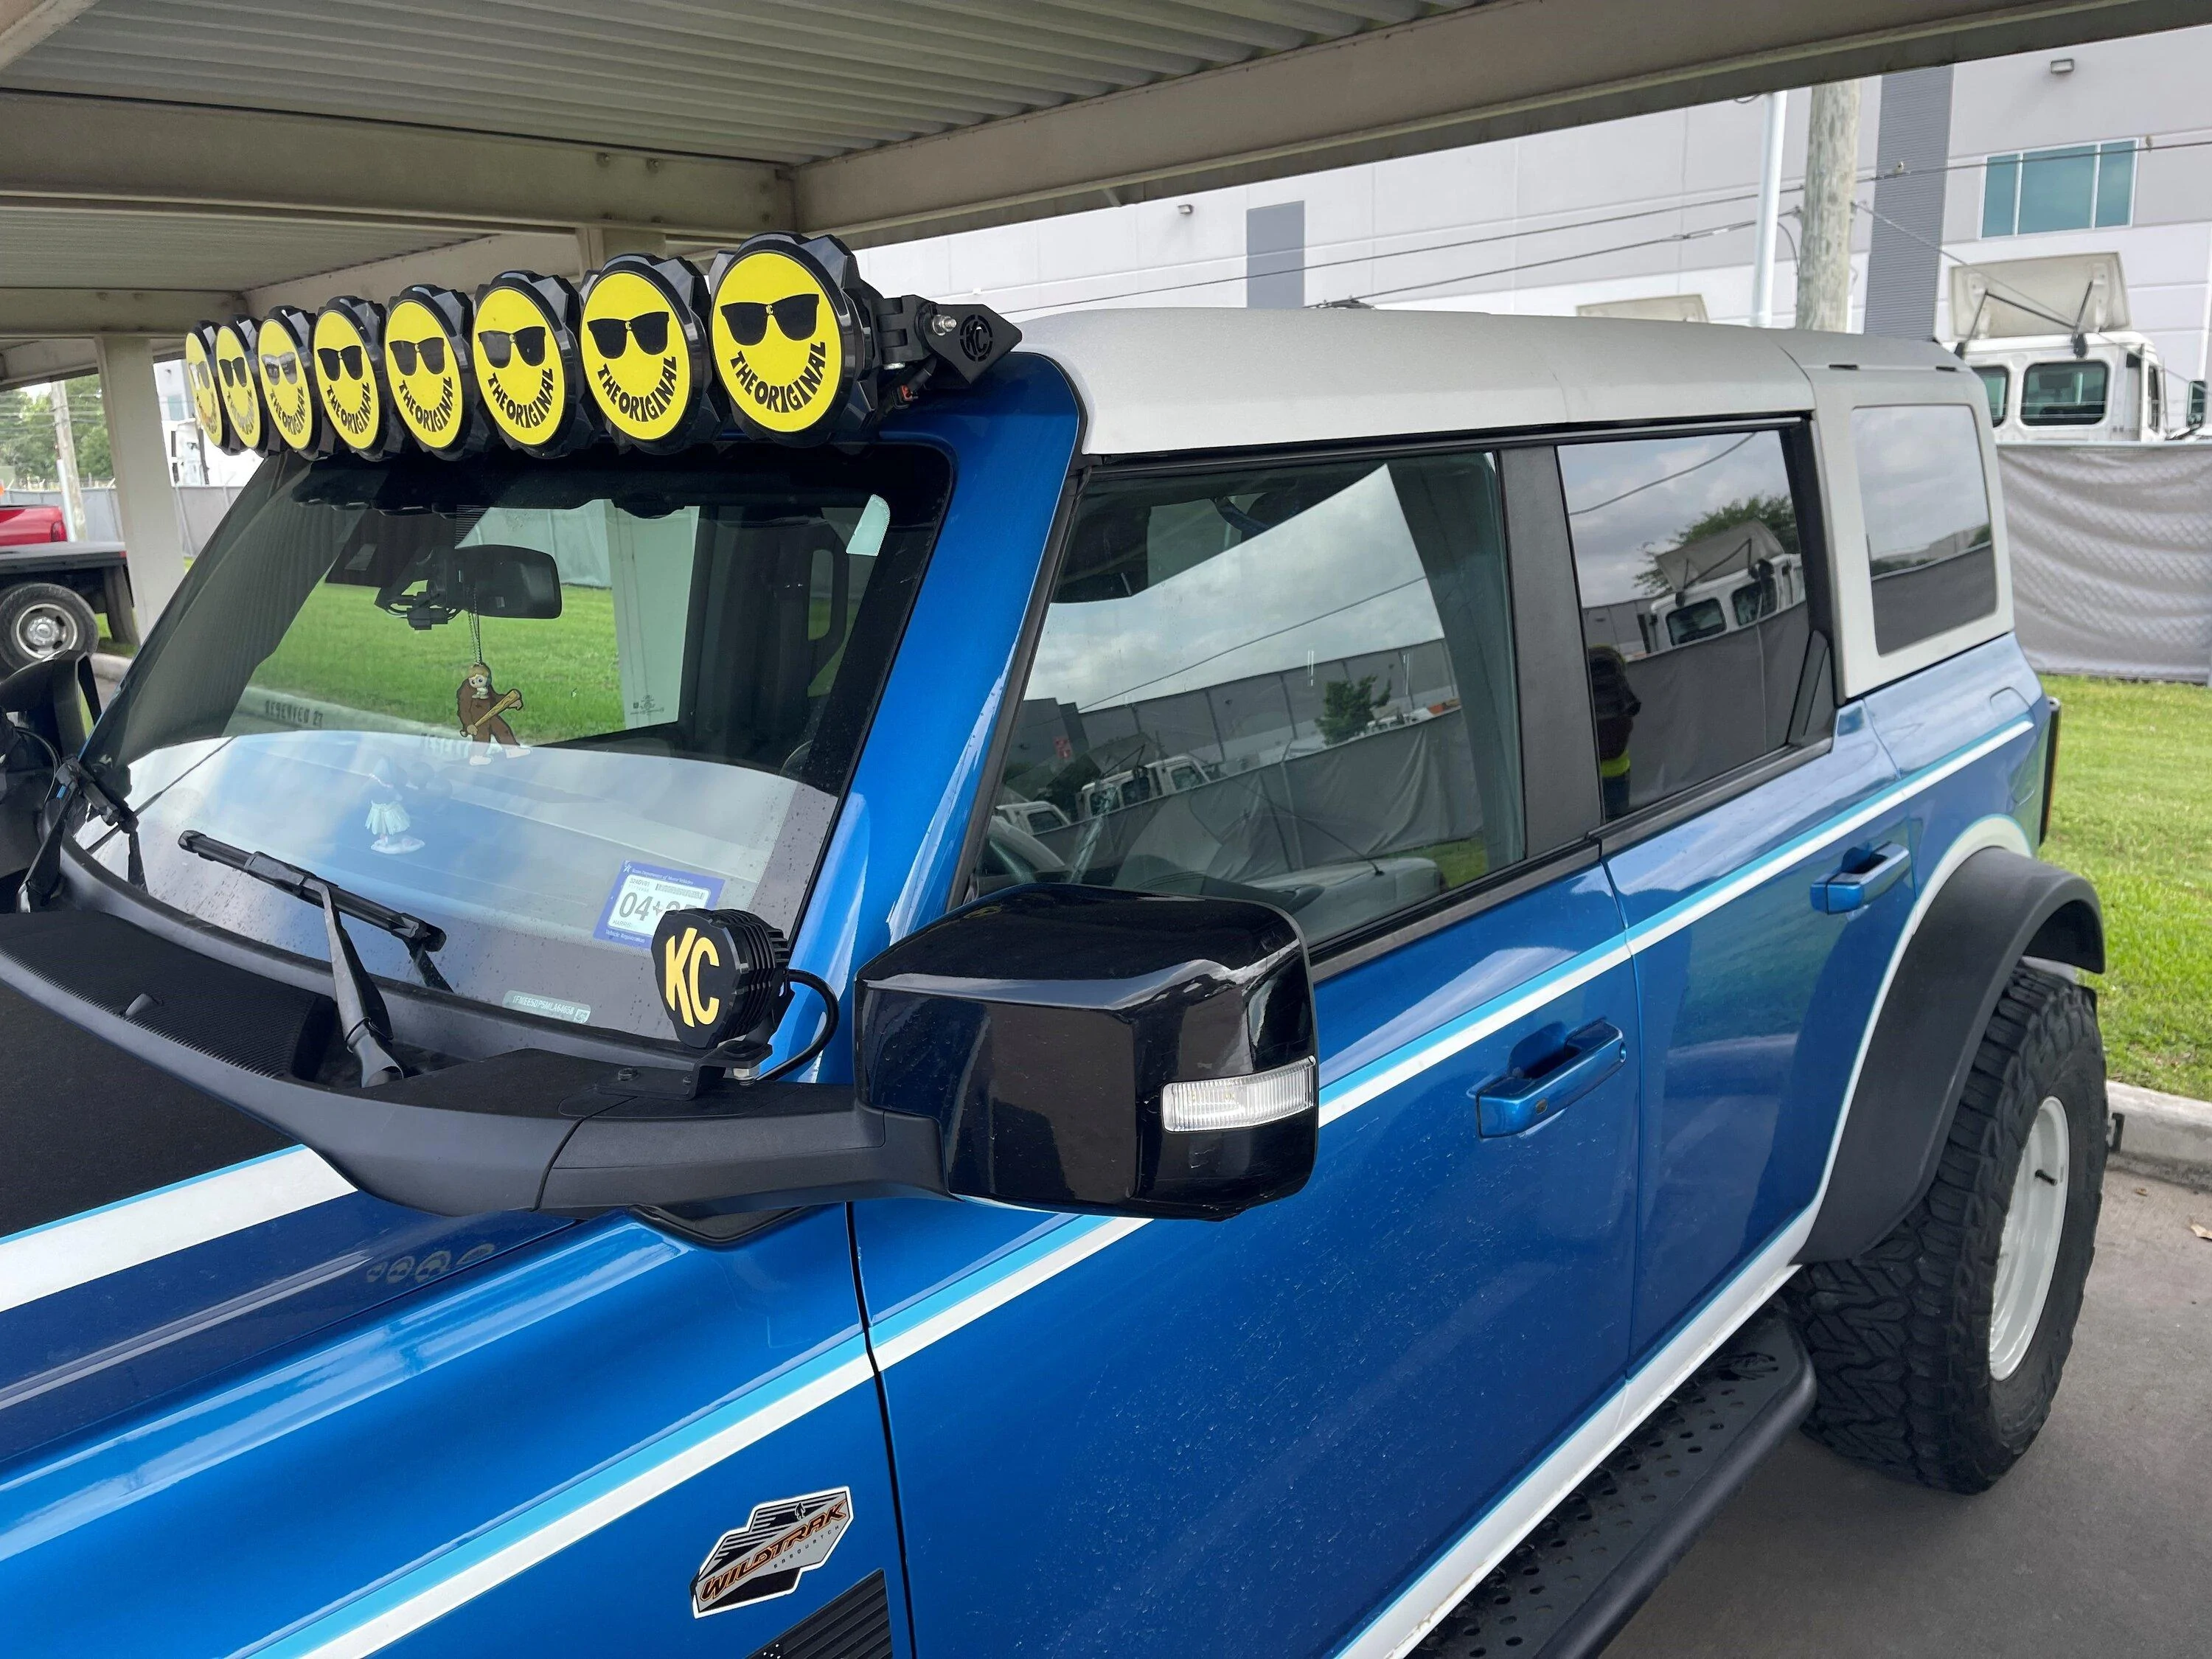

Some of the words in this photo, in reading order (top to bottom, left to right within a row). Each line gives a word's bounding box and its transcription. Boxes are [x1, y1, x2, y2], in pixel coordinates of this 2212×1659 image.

[966, 321, 987, 355] KC
[399, 379, 416, 416] THE
[415, 377, 453, 432] ORIGINAL
[487, 372, 508, 411] THE
[507, 369, 554, 428] ORIGINAL
[597, 363, 622, 405] THE
[619, 356, 677, 422] ORIGINAL
[730, 350, 759, 395] THE
[754, 342, 827, 413] ORIGINAL
[327, 385, 341, 418] THE
[341, 383, 372, 434] ORIGINAL
[619, 891, 653, 921] 04
[664, 927, 721, 1029] KC
[700, 1500, 847, 1601] WILDTRAK
